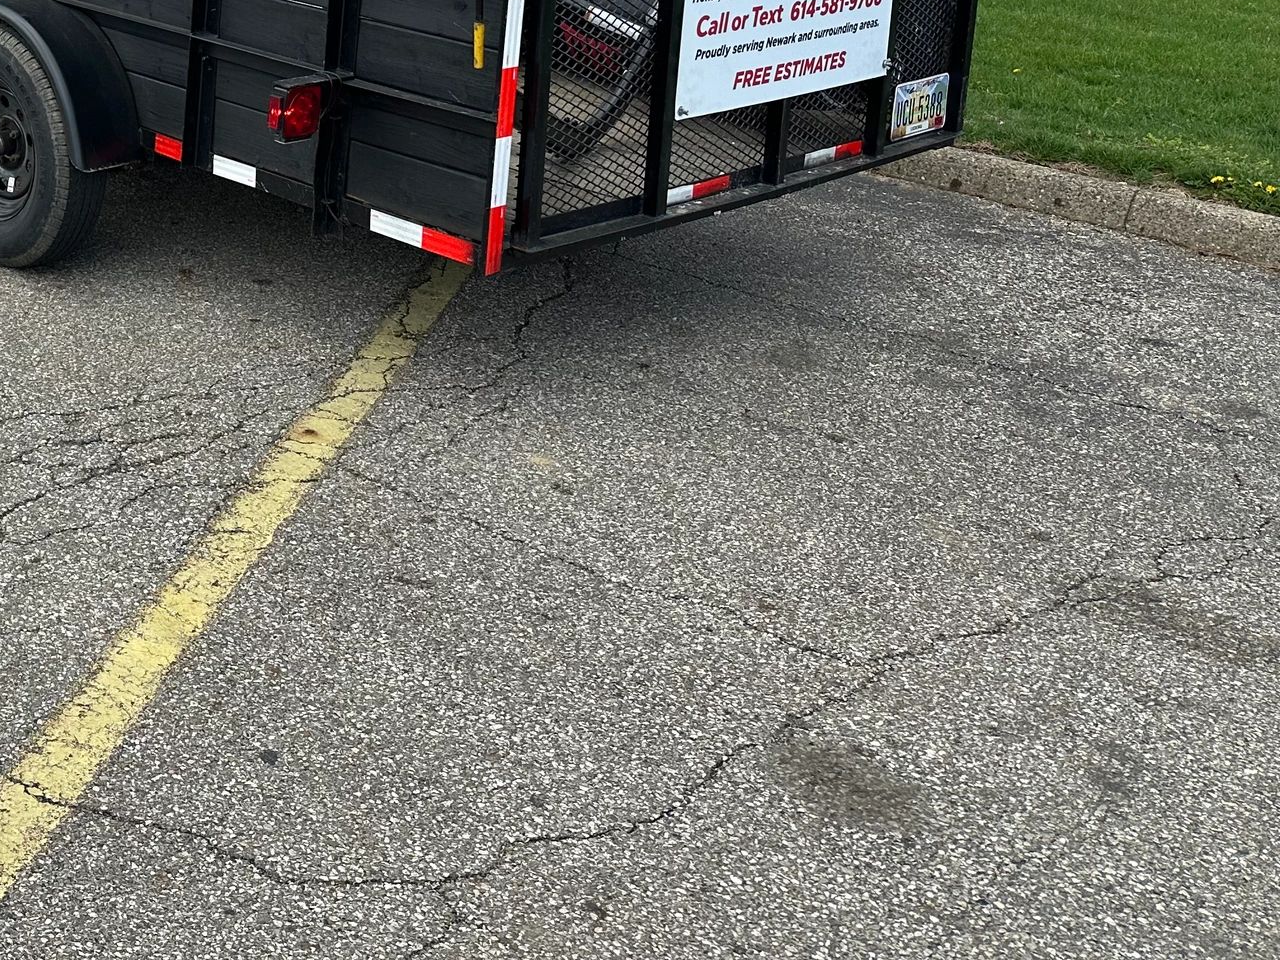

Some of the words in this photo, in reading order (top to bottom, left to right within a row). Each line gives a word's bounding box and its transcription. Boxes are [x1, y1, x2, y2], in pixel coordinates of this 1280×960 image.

[694, 43, 732, 61] Proudly
[731, 39, 765, 55] serving
[765, 32, 797, 49] Newark
[798, 29, 814, 43] and
[813, 21, 859, 40] surrounding
[859, 18, 880, 30] areas.
[696, 11, 730, 38] Call
[731, 14, 750, 32] or
[752, 4, 785, 28] Text
[732, 65, 773, 90] FREE
[773, 50, 848, 82] ESTIMATES
[895, 97, 916, 128] UCU
[917, 90, 944, 122] 5388
